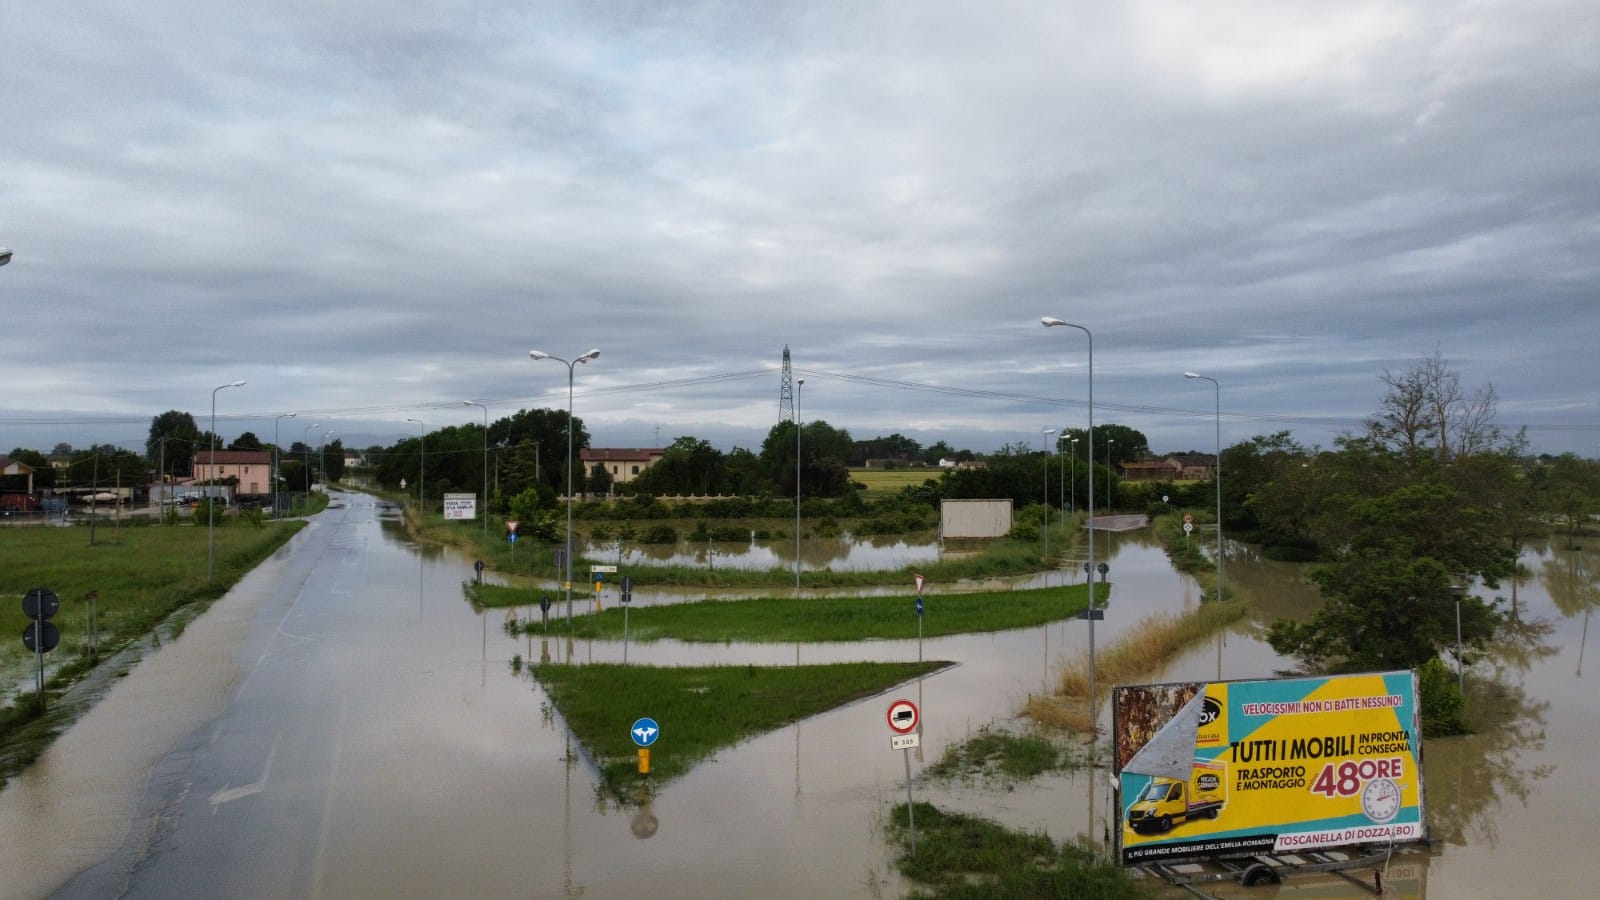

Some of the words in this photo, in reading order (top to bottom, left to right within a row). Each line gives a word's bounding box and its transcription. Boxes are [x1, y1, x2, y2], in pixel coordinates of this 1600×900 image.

[1243, 703, 1301, 715] VELOCISSIMI!
[1303, 702, 1321, 712] NON
[1324, 701, 1332, 711] CI
[1335, 698, 1360, 710] BATTE
[1362, 696, 1402, 708] NESSUNO!
[1359, 733, 1369, 743] IN
[1371, 730, 1410, 742] PRONTA
[1230, 740, 1277, 763] TUTTI
[1281, 740, 1286, 760] I
[1290, 735, 1355, 759] MOBILI
[1358, 742, 1411, 755] CONSEGNA
[1237, 766, 1306, 781] TRASPORTO
[1312, 761, 1360, 796] 48
[1358, 758, 1402, 780] ORE
[1236, 783, 1242, 791] E
[1243, 778, 1306, 790] MONTAGGIO
[1279, 833, 1343, 846] TOSCANELLA
[1345, 830, 1354, 840] DI
[1357, 827, 1390, 839] DOZZA
[1144, 847, 1170, 856] GRANDE
[1171, 844, 1204, 853] MOBILIERE
